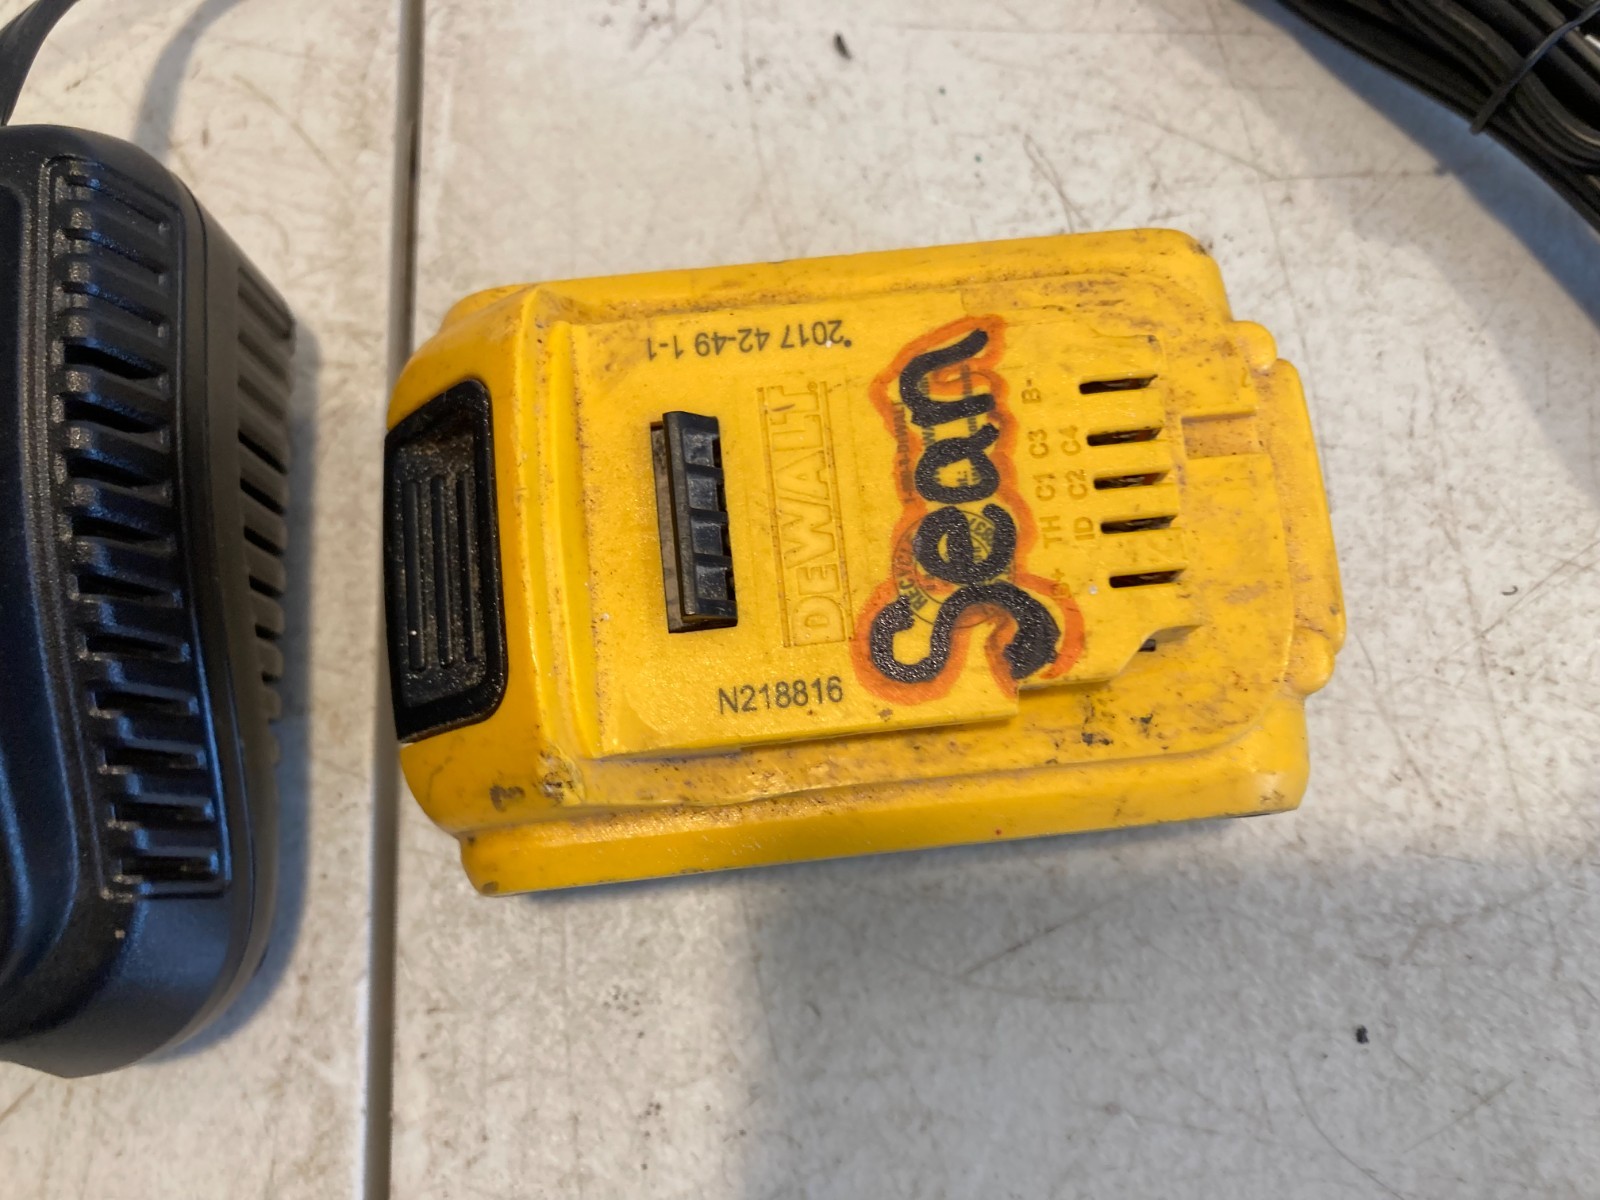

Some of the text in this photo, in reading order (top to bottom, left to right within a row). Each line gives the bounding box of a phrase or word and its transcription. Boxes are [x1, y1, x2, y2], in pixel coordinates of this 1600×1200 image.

[648, 335, 684, 361] 1-1
[695, 328, 769, 357] 42-49
[1021, 379, 1042, 405] B-
[1027, 428, 1050, 459] C3
[1033, 473, 1056, 501] C1
[1058, 424, 1095, 541] ID C2 C4
[764, 383, 846, 648] DEWALT
[870, 328, 1061, 684] Sean
[1039, 515, 1062, 549] TH
[719, 676, 843, 715] N218816
